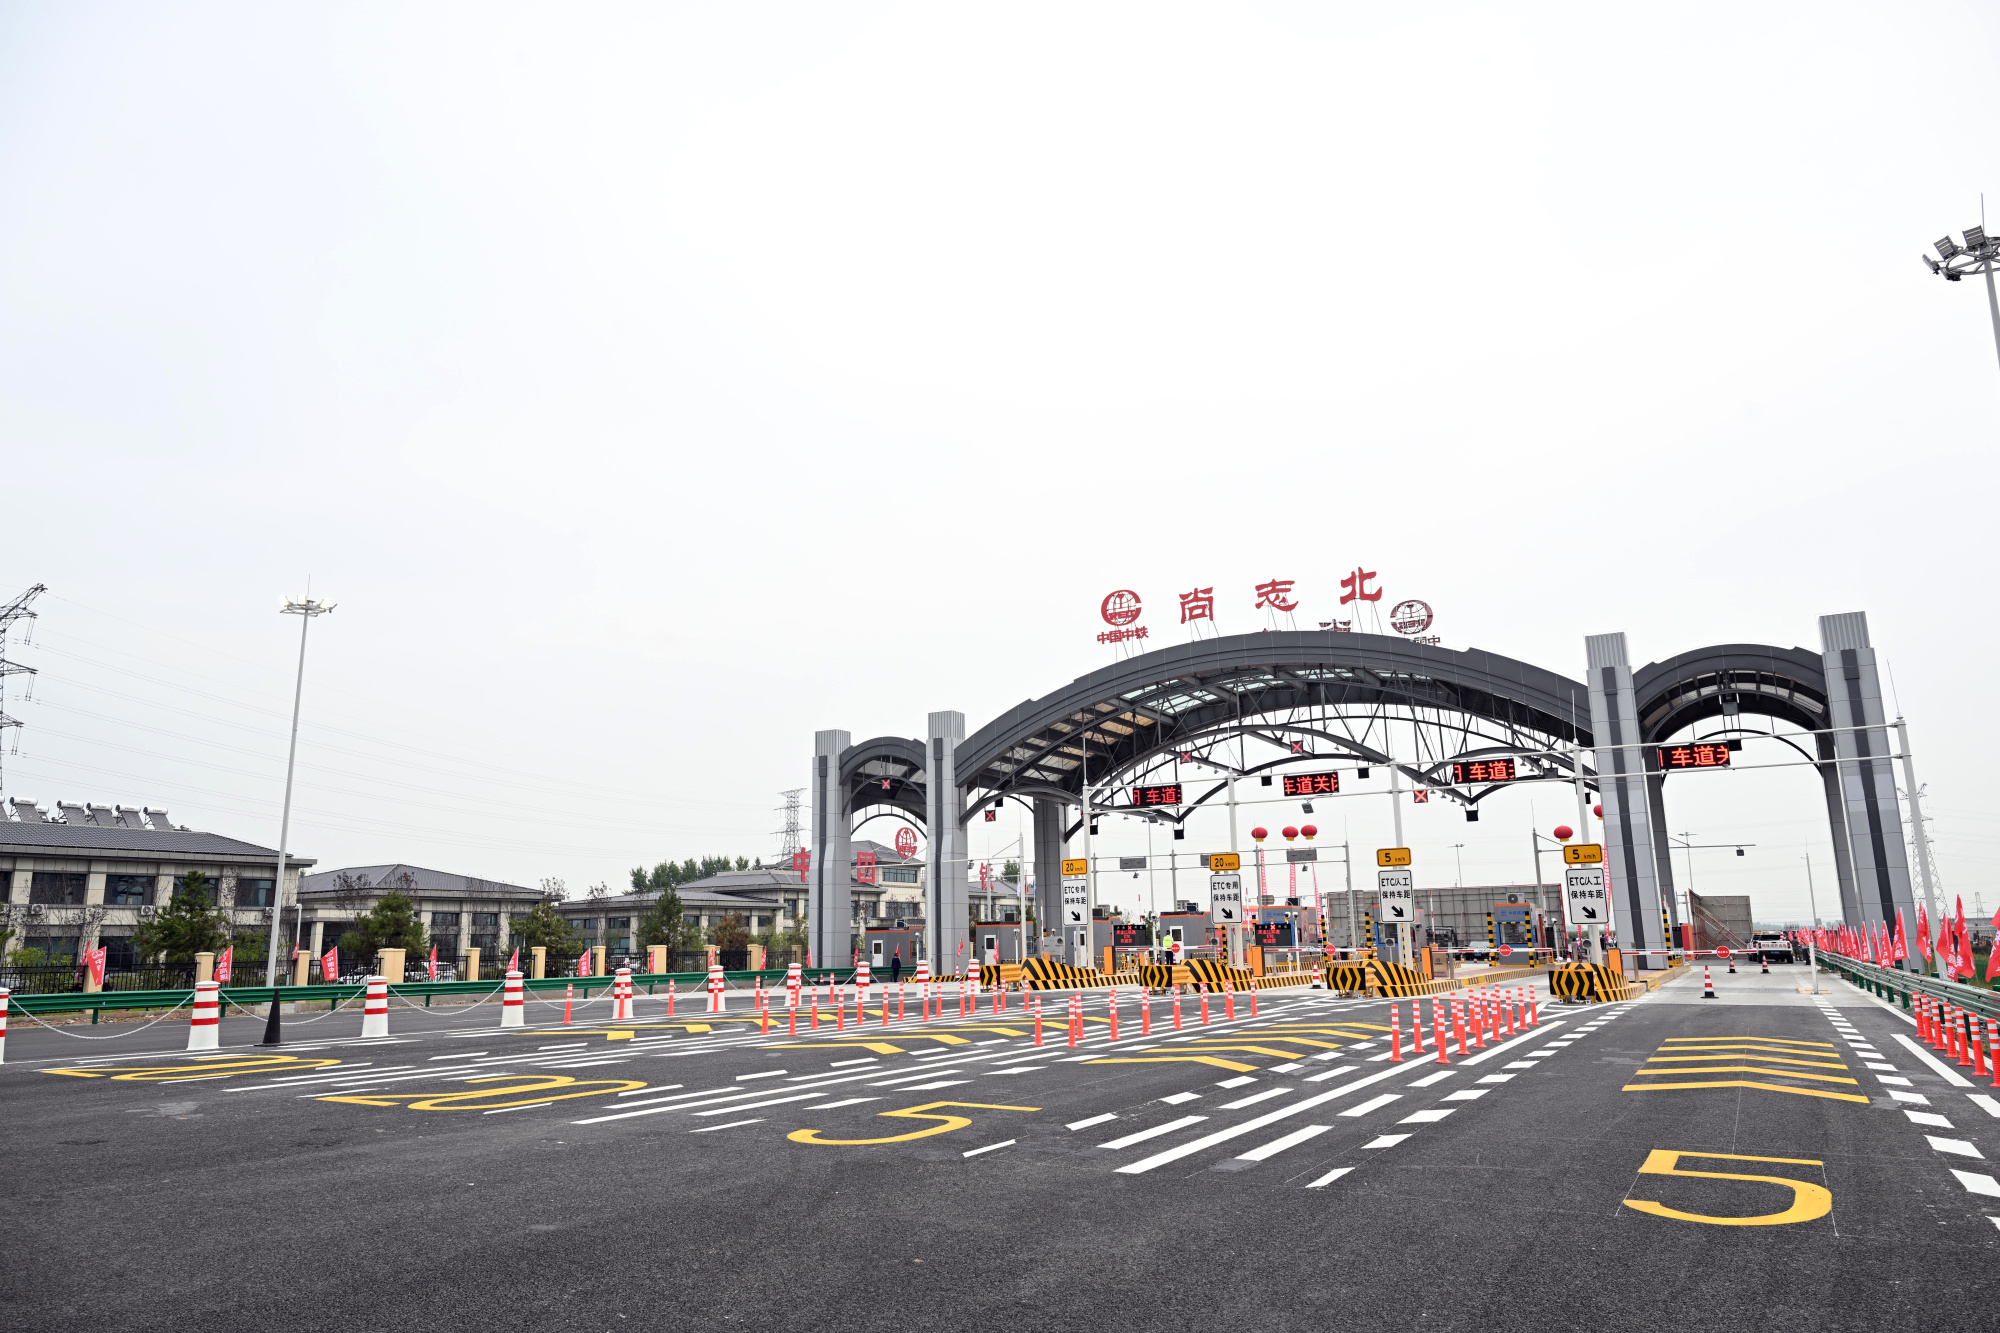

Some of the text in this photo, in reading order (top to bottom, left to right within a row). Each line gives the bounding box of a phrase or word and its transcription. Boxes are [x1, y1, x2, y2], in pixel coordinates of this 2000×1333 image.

[1178, 566, 1383, 625] 尚志北
[1096, 625, 1149, 644] 中国中铁
[1469, 760, 1515, 781] 车道
[1146, 786, 1181, 804] 车道
[1384, 852, 1391, 863] 5
[1572, 849, 1580, 860] 5
[1065, 862, 1074, 872] 20
[1214, 857, 1224, 867] 20
[1212, 881, 1239, 890] ETC专用
[1381, 877, 1409, 887] ETC/人工
[1569, 876, 1601, 886] ETC/人工
[1213, 893, 1240, 902] 保持车距
[1382, 889, 1411, 899] 保持车距
[1571, 890, 1604, 899] 保持车距
[320, 1075, 648, 1110] 20
[786, 1101, 1043, 1145] 5
[1622, 1149, 1833, 1226] 5
